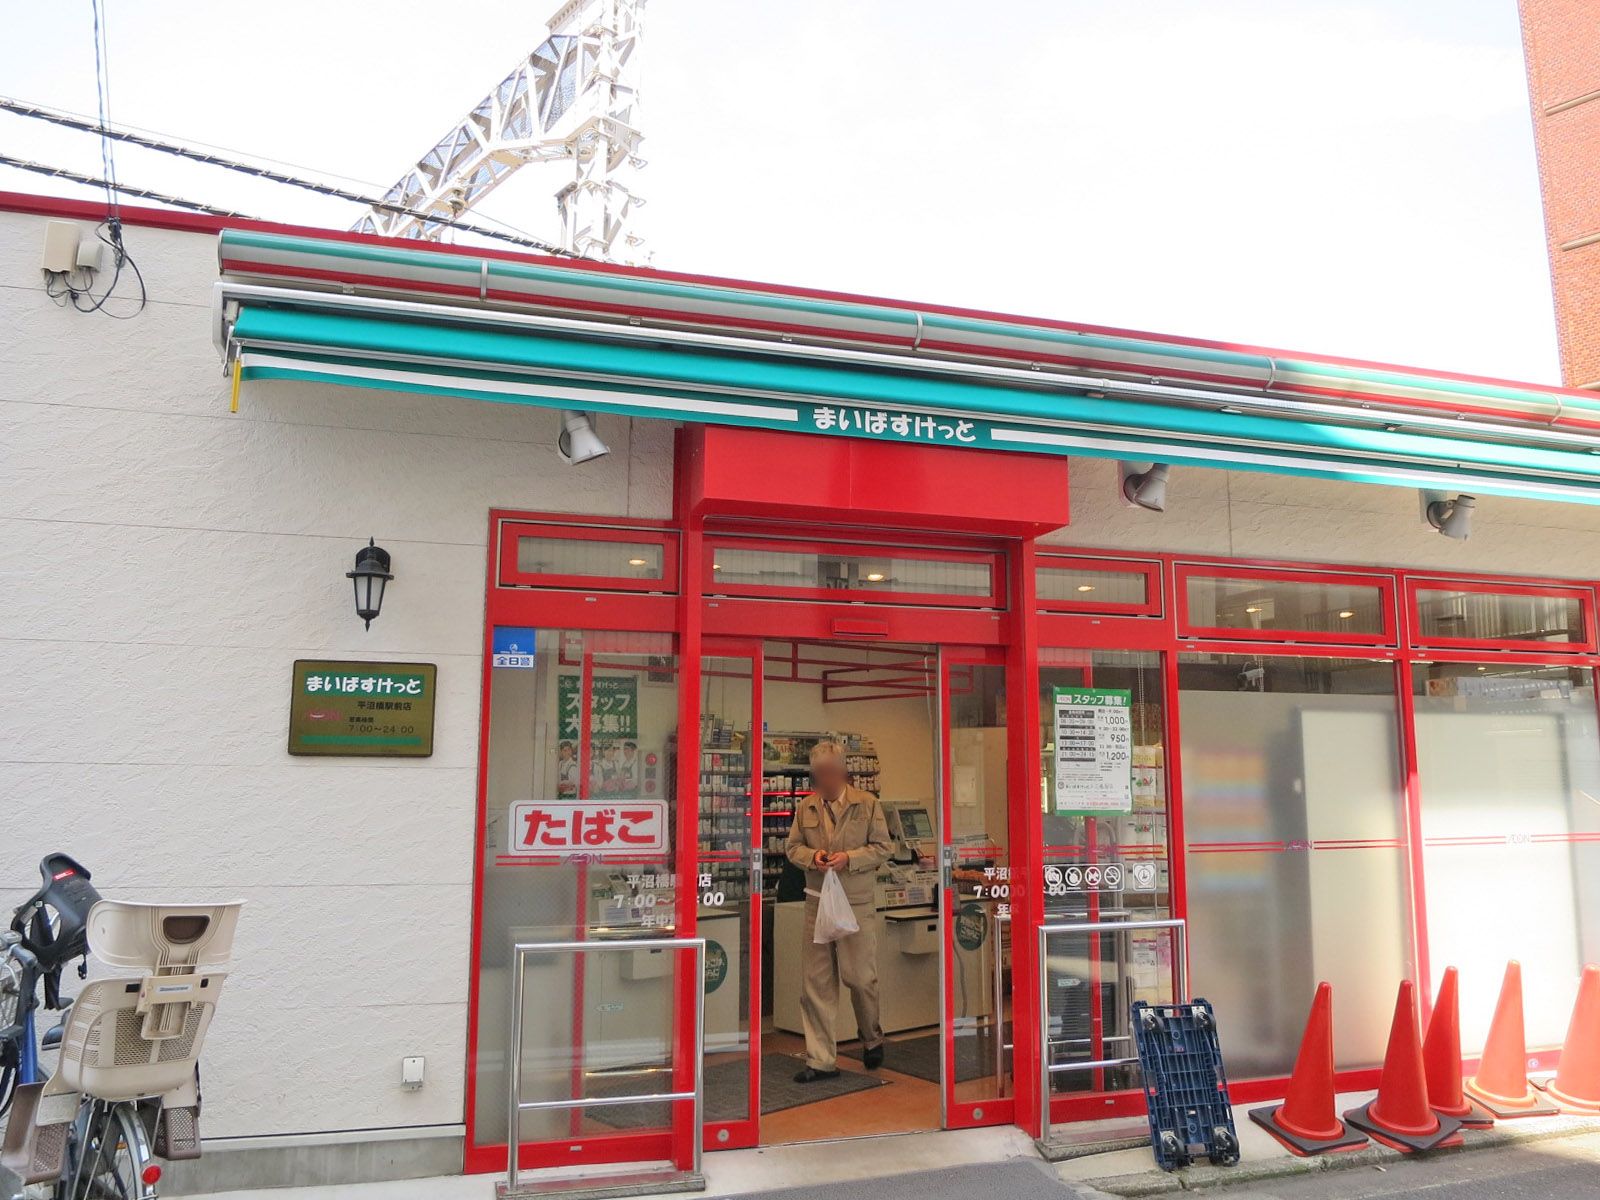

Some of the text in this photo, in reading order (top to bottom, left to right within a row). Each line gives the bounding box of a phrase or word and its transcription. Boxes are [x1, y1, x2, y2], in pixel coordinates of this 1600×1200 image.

[813, 407, 976, 442] まいばすけっと
[306, 676, 422, 694] まいばすけっと
[523, 809, 656, 846] たばこ
